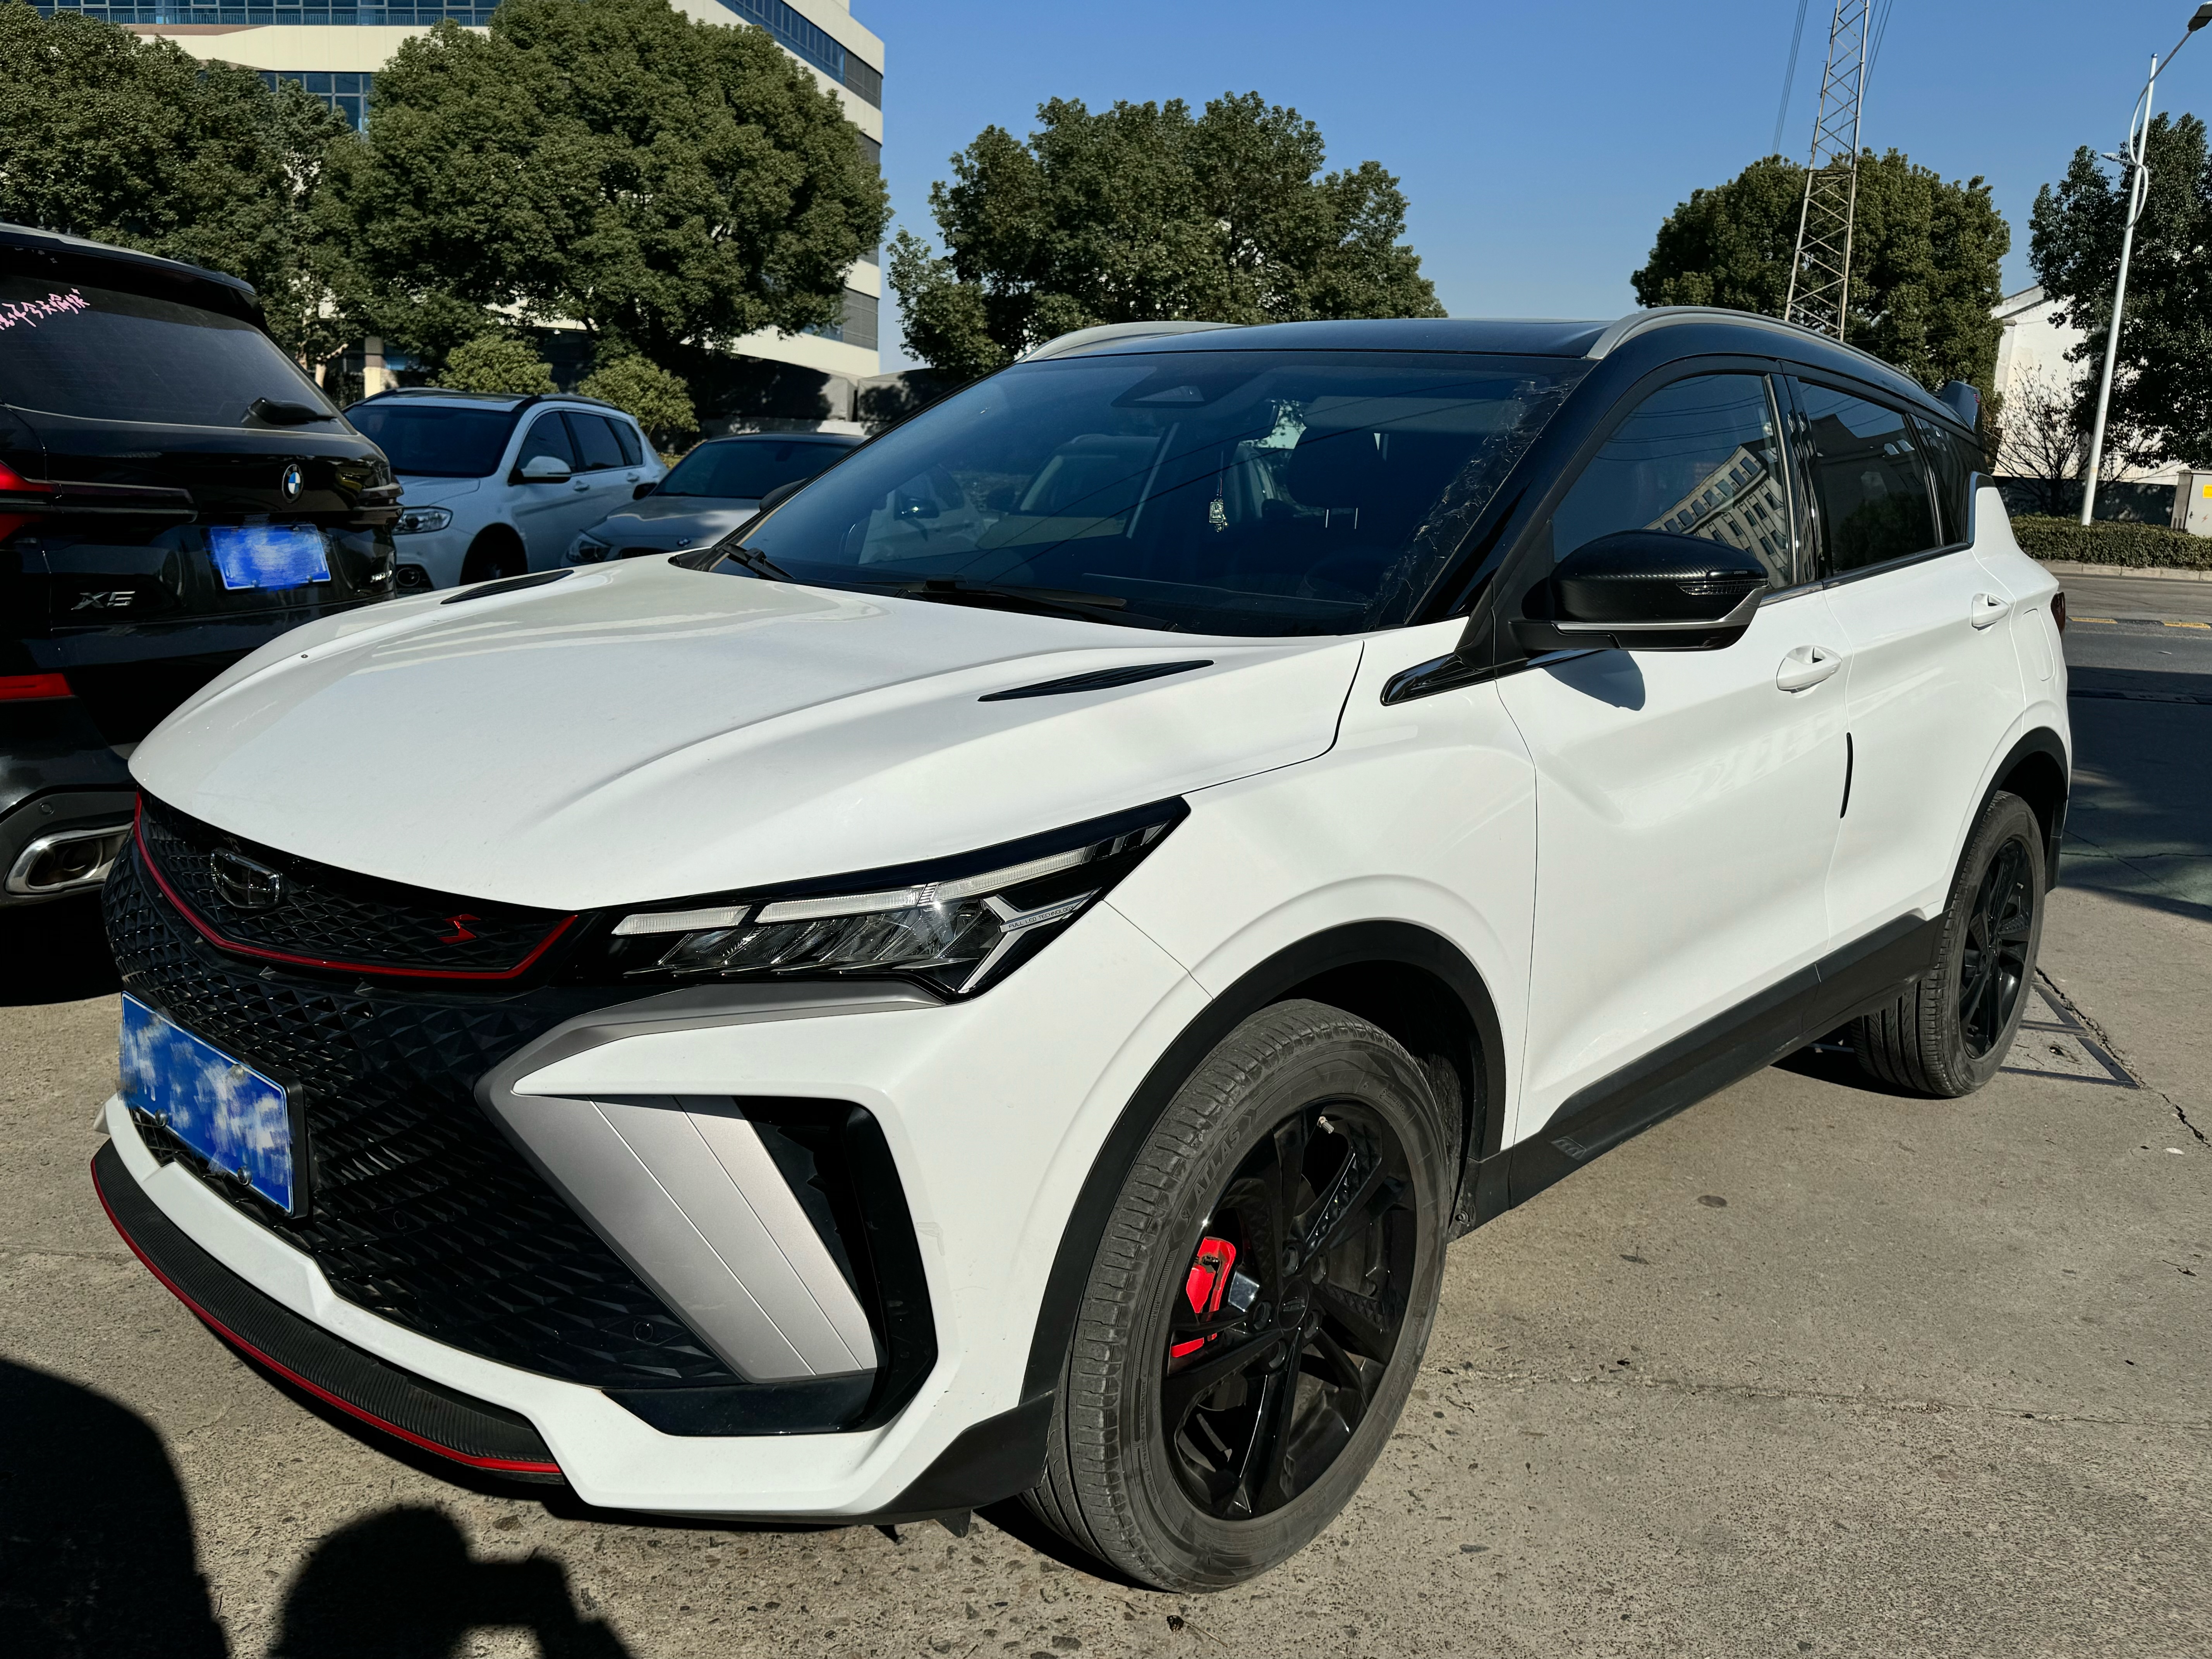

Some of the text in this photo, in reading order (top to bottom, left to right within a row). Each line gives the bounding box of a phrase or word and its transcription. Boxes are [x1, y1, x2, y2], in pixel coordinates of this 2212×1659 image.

[0, 293, 90, 330] 你今天愉快
[1008, 921, 1024, 929] FULL
[1038, 905, 1074, 920] TECHNOLOGY
[1193, 1126, 1240, 1205] ATLAS
[1147, 1474, 1158, 1503] TREADWEAR
